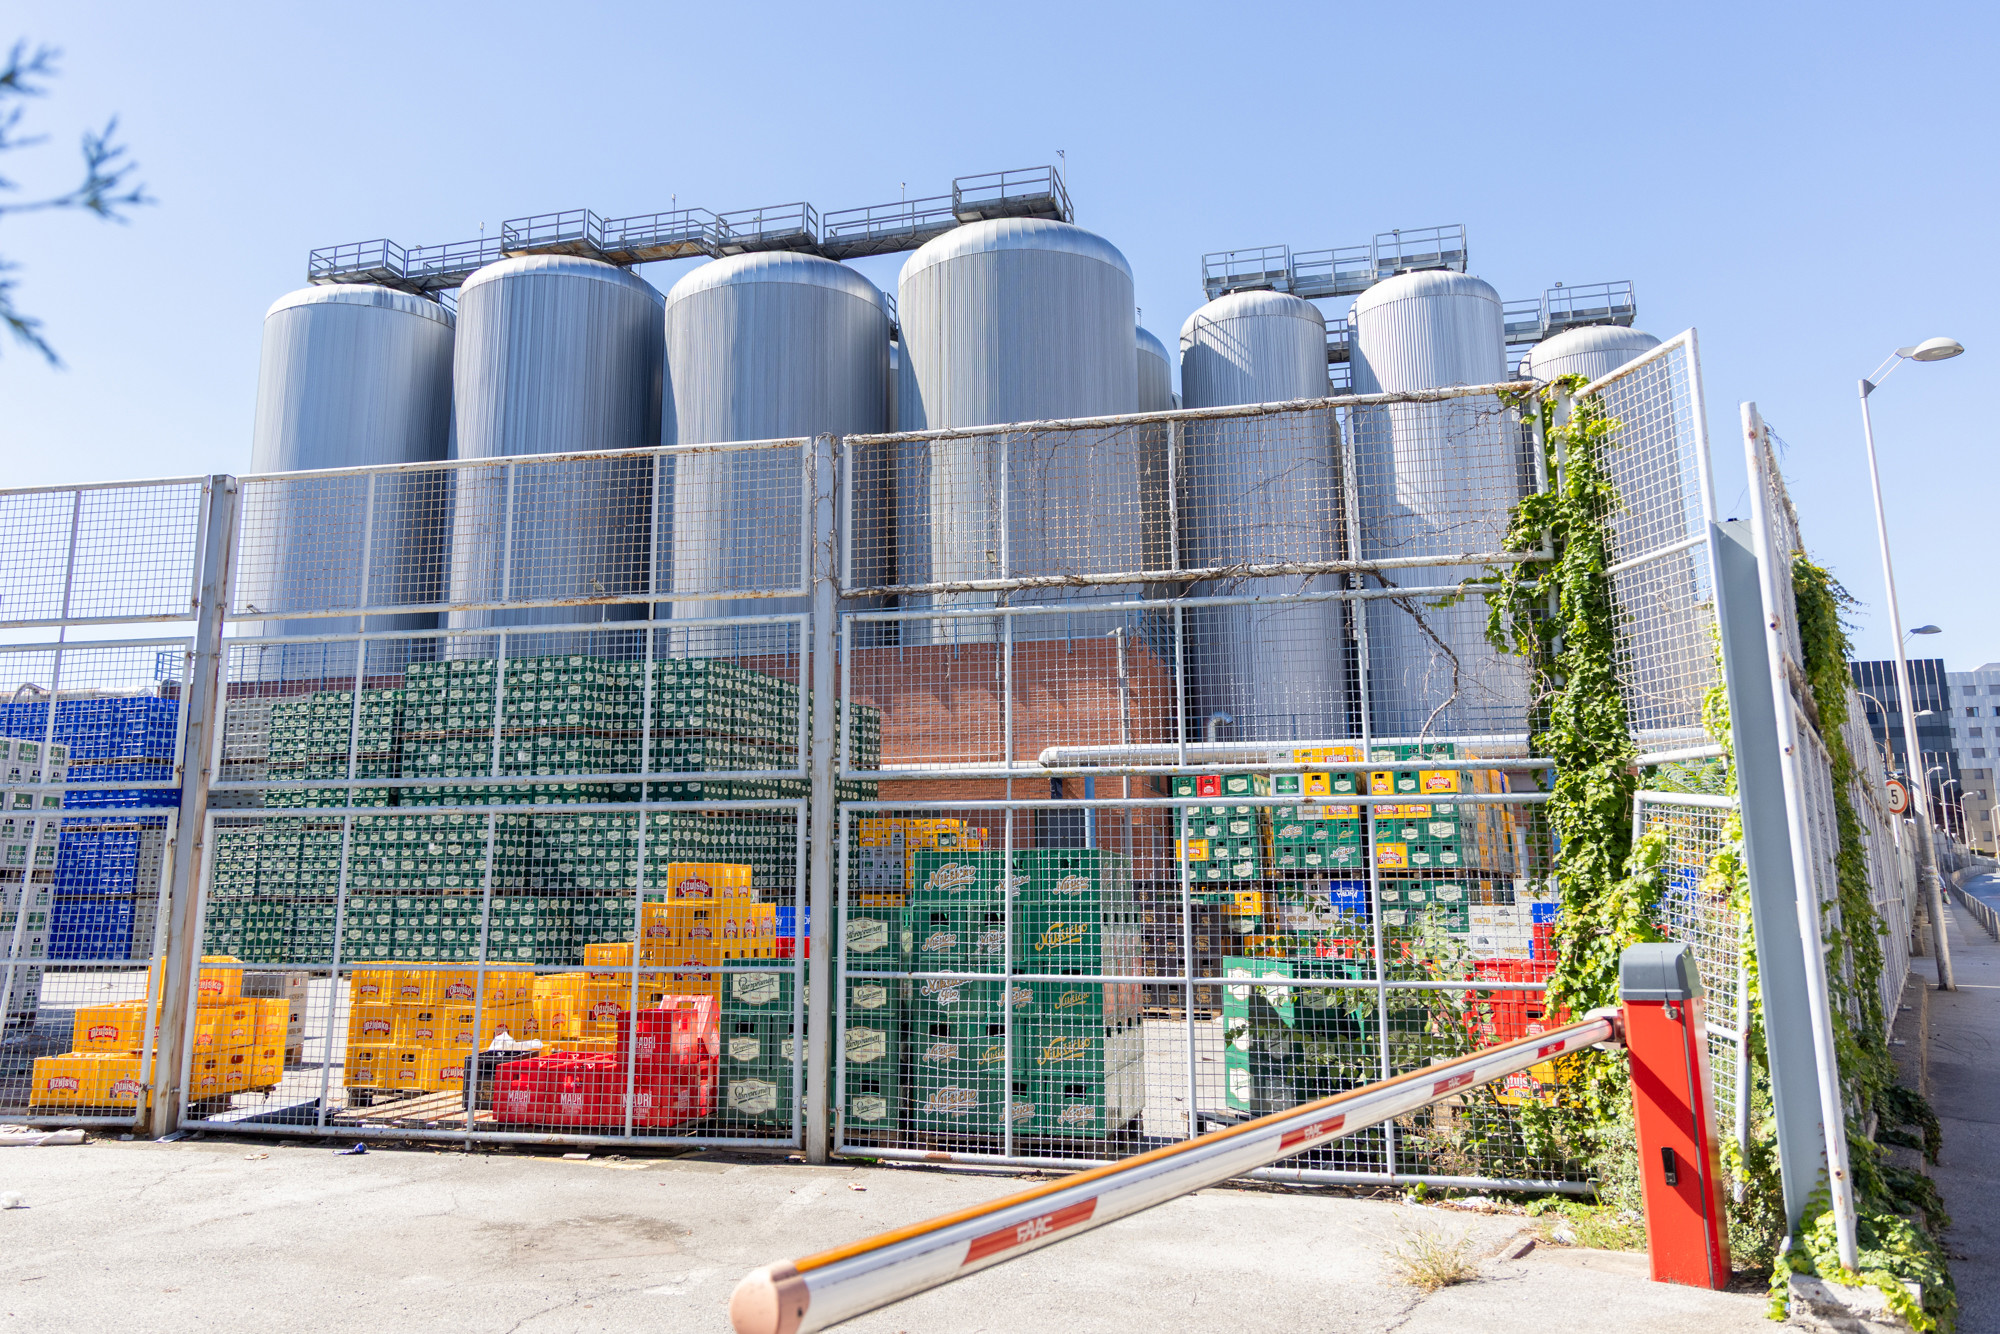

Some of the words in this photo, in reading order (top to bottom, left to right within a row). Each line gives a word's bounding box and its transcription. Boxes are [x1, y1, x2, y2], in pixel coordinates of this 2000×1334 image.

[1035, 922, 1088, 951] Nikšićko
[1036, 1036, 1092, 1065] Nikšićko
[1015, 1215, 1053, 1243] FAAC
